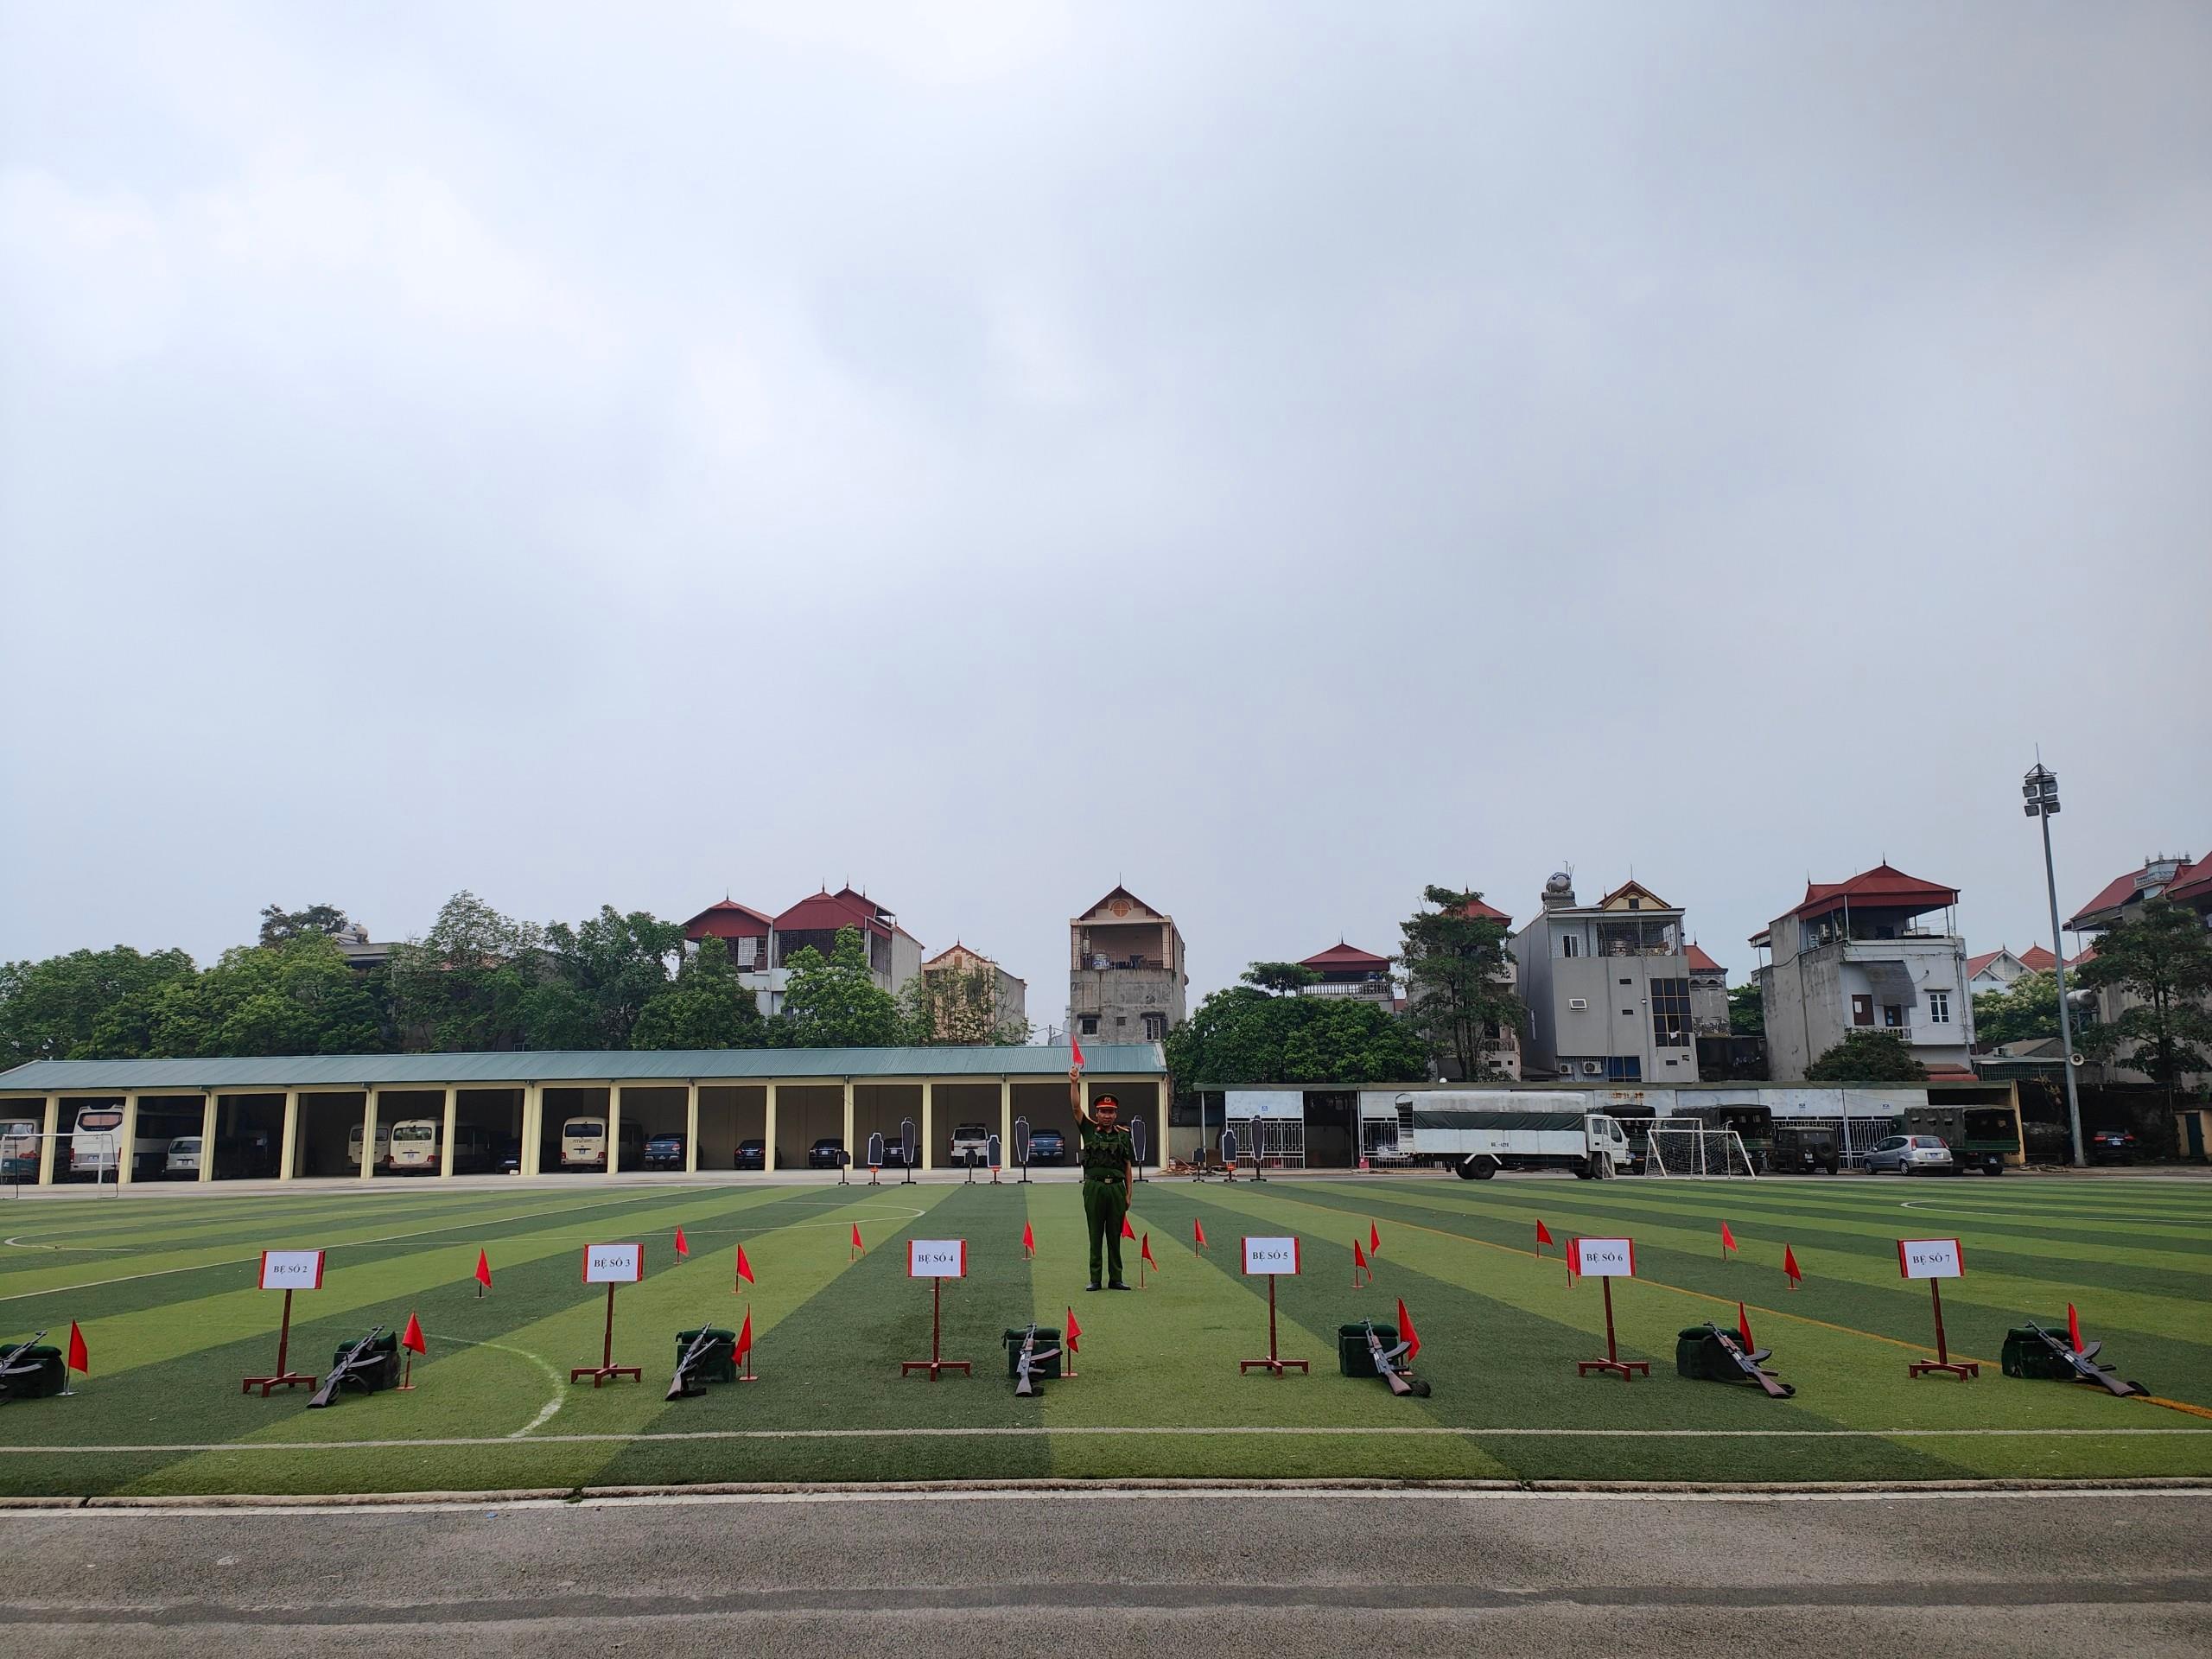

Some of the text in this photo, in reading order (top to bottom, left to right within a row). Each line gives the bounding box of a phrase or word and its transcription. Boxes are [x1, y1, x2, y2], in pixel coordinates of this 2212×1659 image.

[1282, 1251, 1288, 1260] 5
[1945, 1254, 1950, 1262] 7
[625, 1258, 631, 1267] 3
